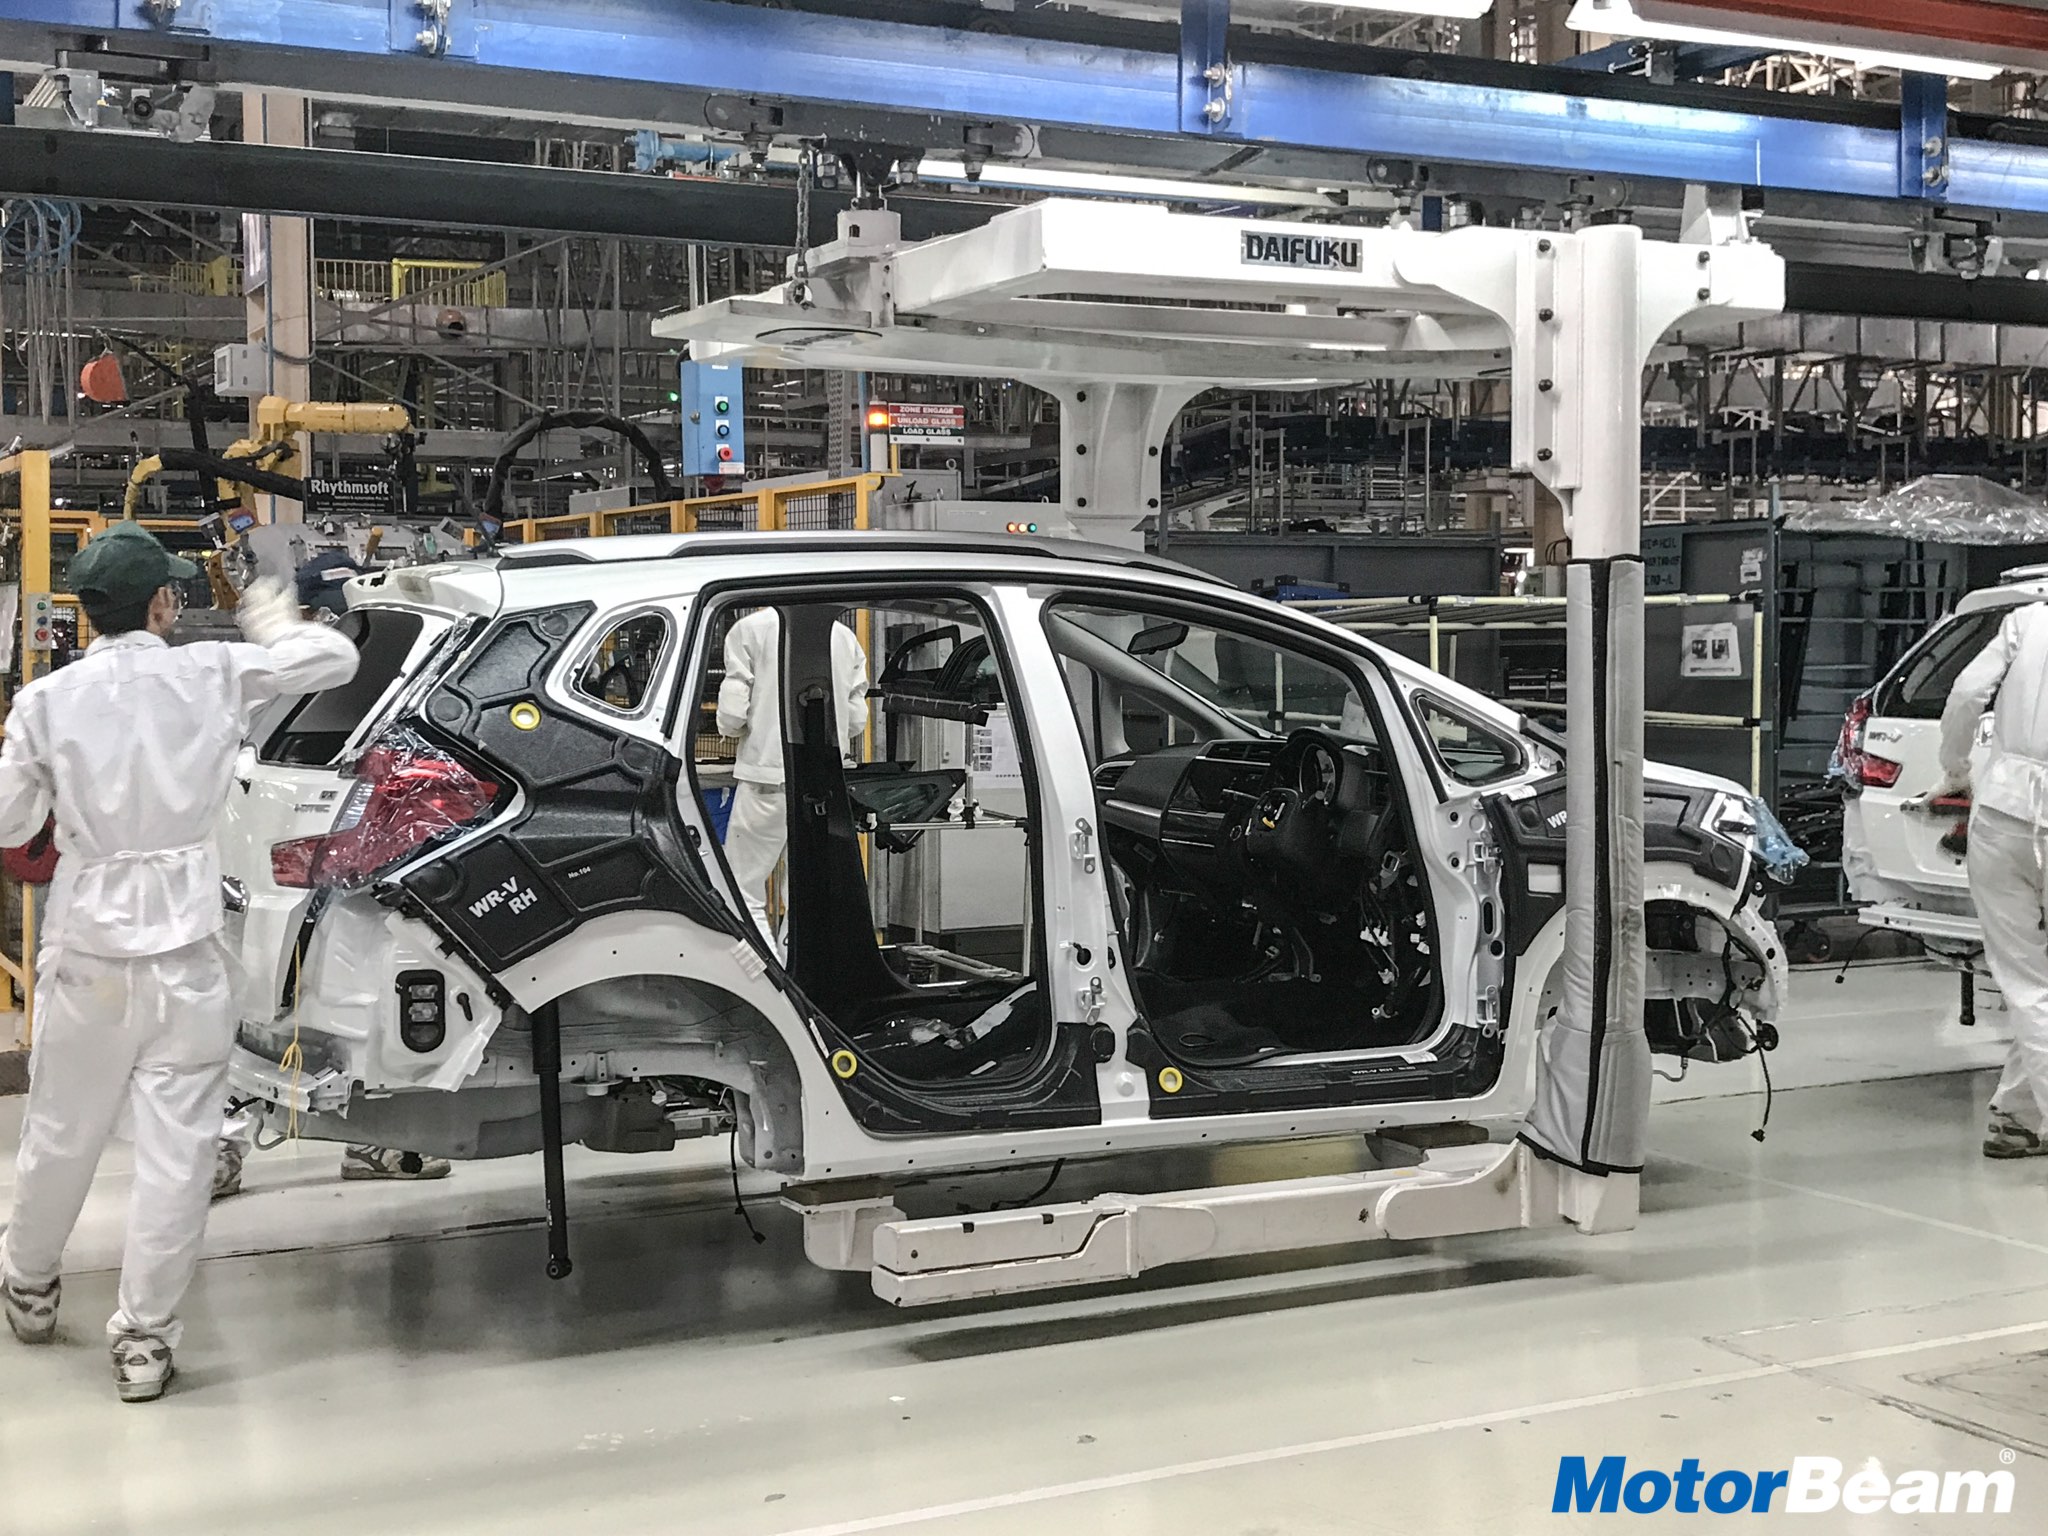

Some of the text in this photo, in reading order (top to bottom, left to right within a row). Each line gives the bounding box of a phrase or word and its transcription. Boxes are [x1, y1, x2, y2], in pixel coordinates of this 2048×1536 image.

[1246, 234, 1358, 267] DAIFUKU
[926, 428, 951, 436] GLASS
[311, 479, 389, 496] Rhythmsoft
[468, 875, 518, 918] WR-V
[507, 887, 538, 915] RH
